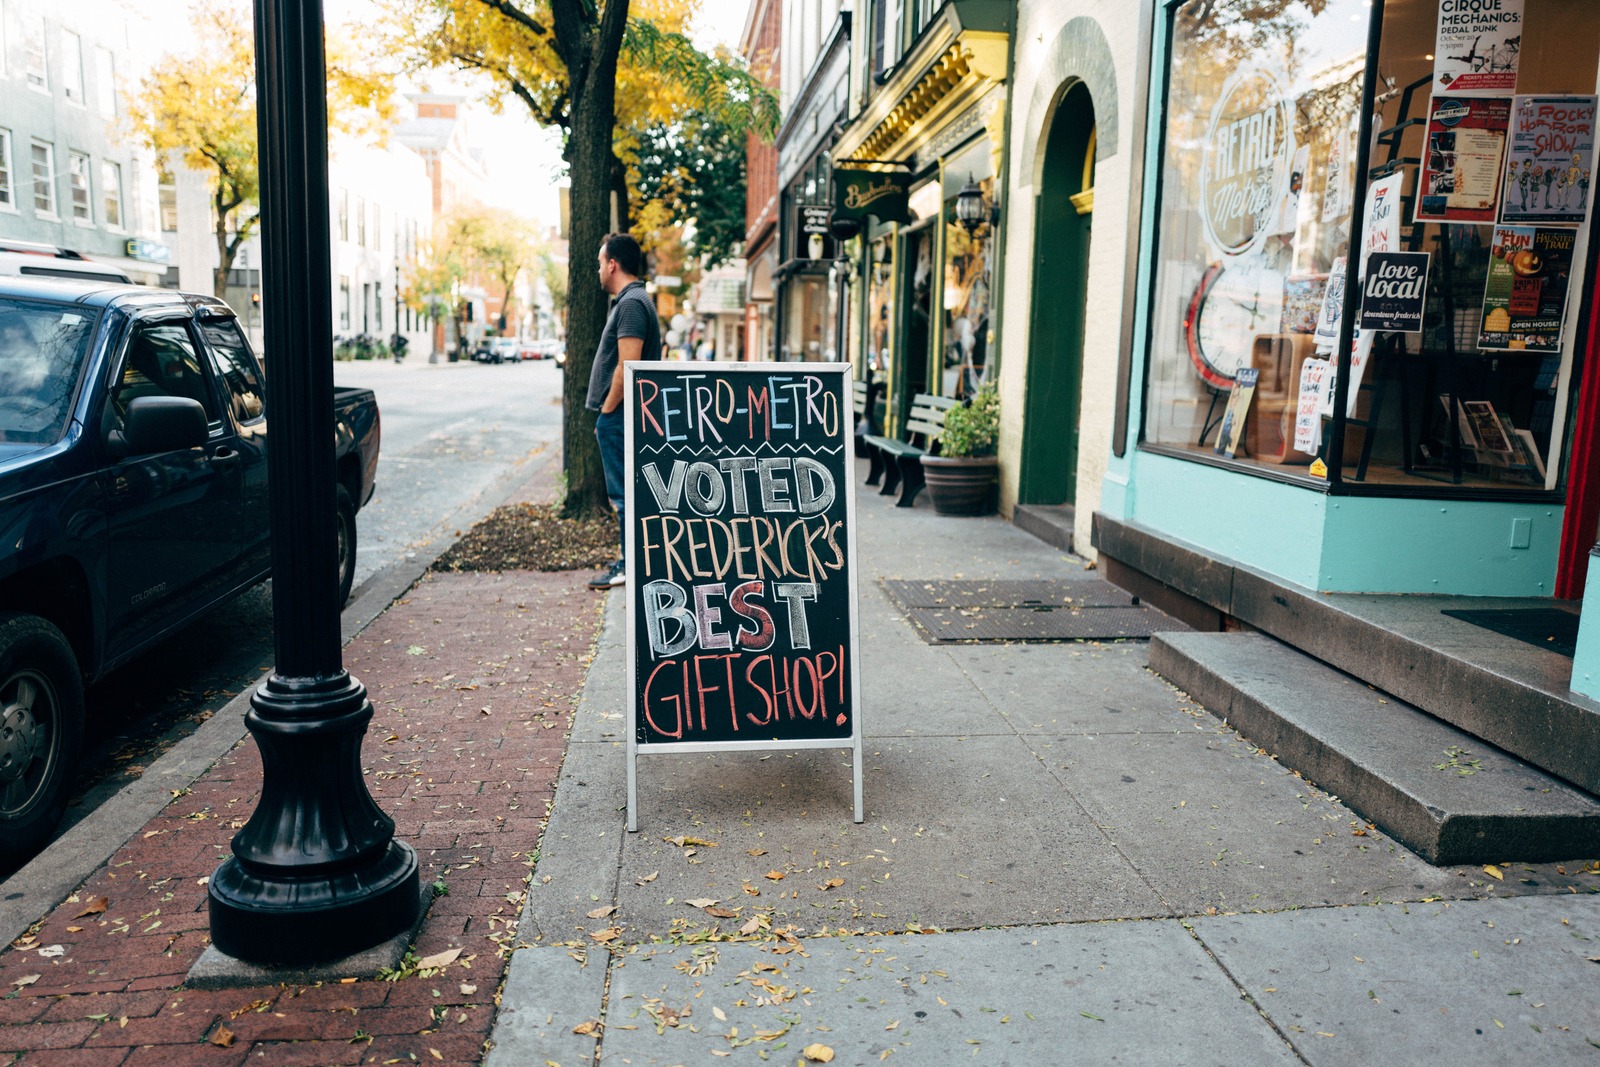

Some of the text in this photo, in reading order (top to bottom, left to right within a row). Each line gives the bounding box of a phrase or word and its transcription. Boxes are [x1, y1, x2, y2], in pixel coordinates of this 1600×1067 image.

[1442, 0, 1501, 13] CIRQUE
[1442, 13, 1521, 25] MECHANICS:
[1441, 25, 1497, 34] PEDAL PUNK
[1517, 106, 1595, 122] THE ROCKY
[1520, 118, 1590, 135] HORROR
[1215, 106, 1277, 182] RETRO
[1533, 133, 1577, 156] SHOW
[1213, 176, 1270, 231] Metro
[1501, 235, 1530, 246] FUN
[1536, 233, 1574, 243] HAUNTED
[1545, 241, 1570, 249] TRAIL
[1378, 260, 1418, 279] love
[1366, 274, 1424, 299] local
[1364, 310, 1420, 320] downtown frederick
[1236, 356, 1243, 367] 6
[636, 374, 838, 443] RETRO-METRO
[641, 457, 836, 519] VOTED
[640, 513, 845, 584] FREDERICK'S
[131, 582, 166, 604] COLORADO
[642, 579, 822, 661] BEST
[644, 645, 847, 739] GIFT SHOP!
